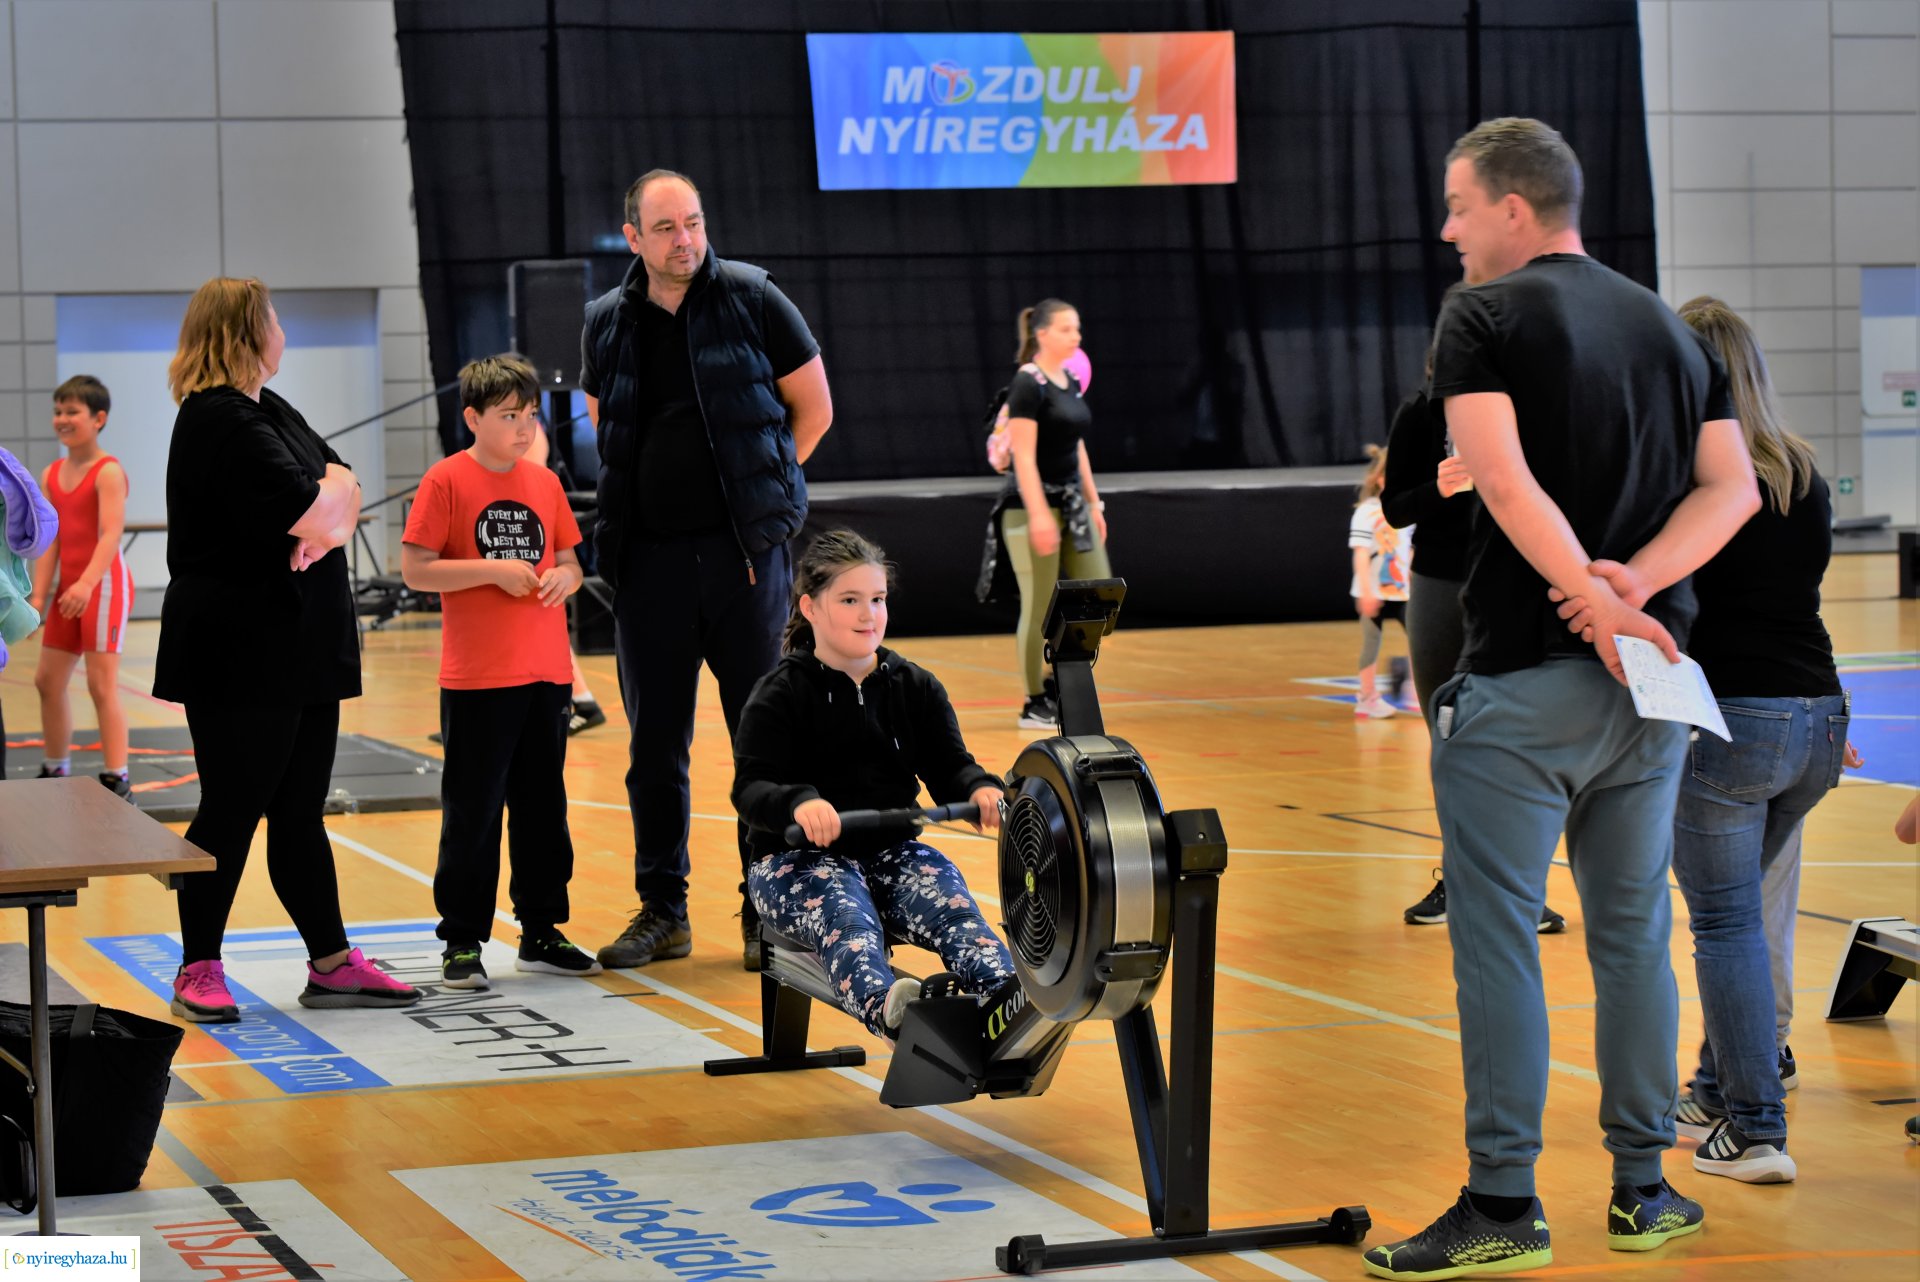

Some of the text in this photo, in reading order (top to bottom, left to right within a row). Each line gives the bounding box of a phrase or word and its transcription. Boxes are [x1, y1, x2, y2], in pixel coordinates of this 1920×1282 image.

[838, 108, 1209, 154] NYÍREGYHÁZA
[487, 509, 528, 520] EVERY DAY
[497, 522, 523, 534] IS THE
[493, 535, 530, 547] BEST DAY
[486, 549, 540, 560] OF THE YEAR
